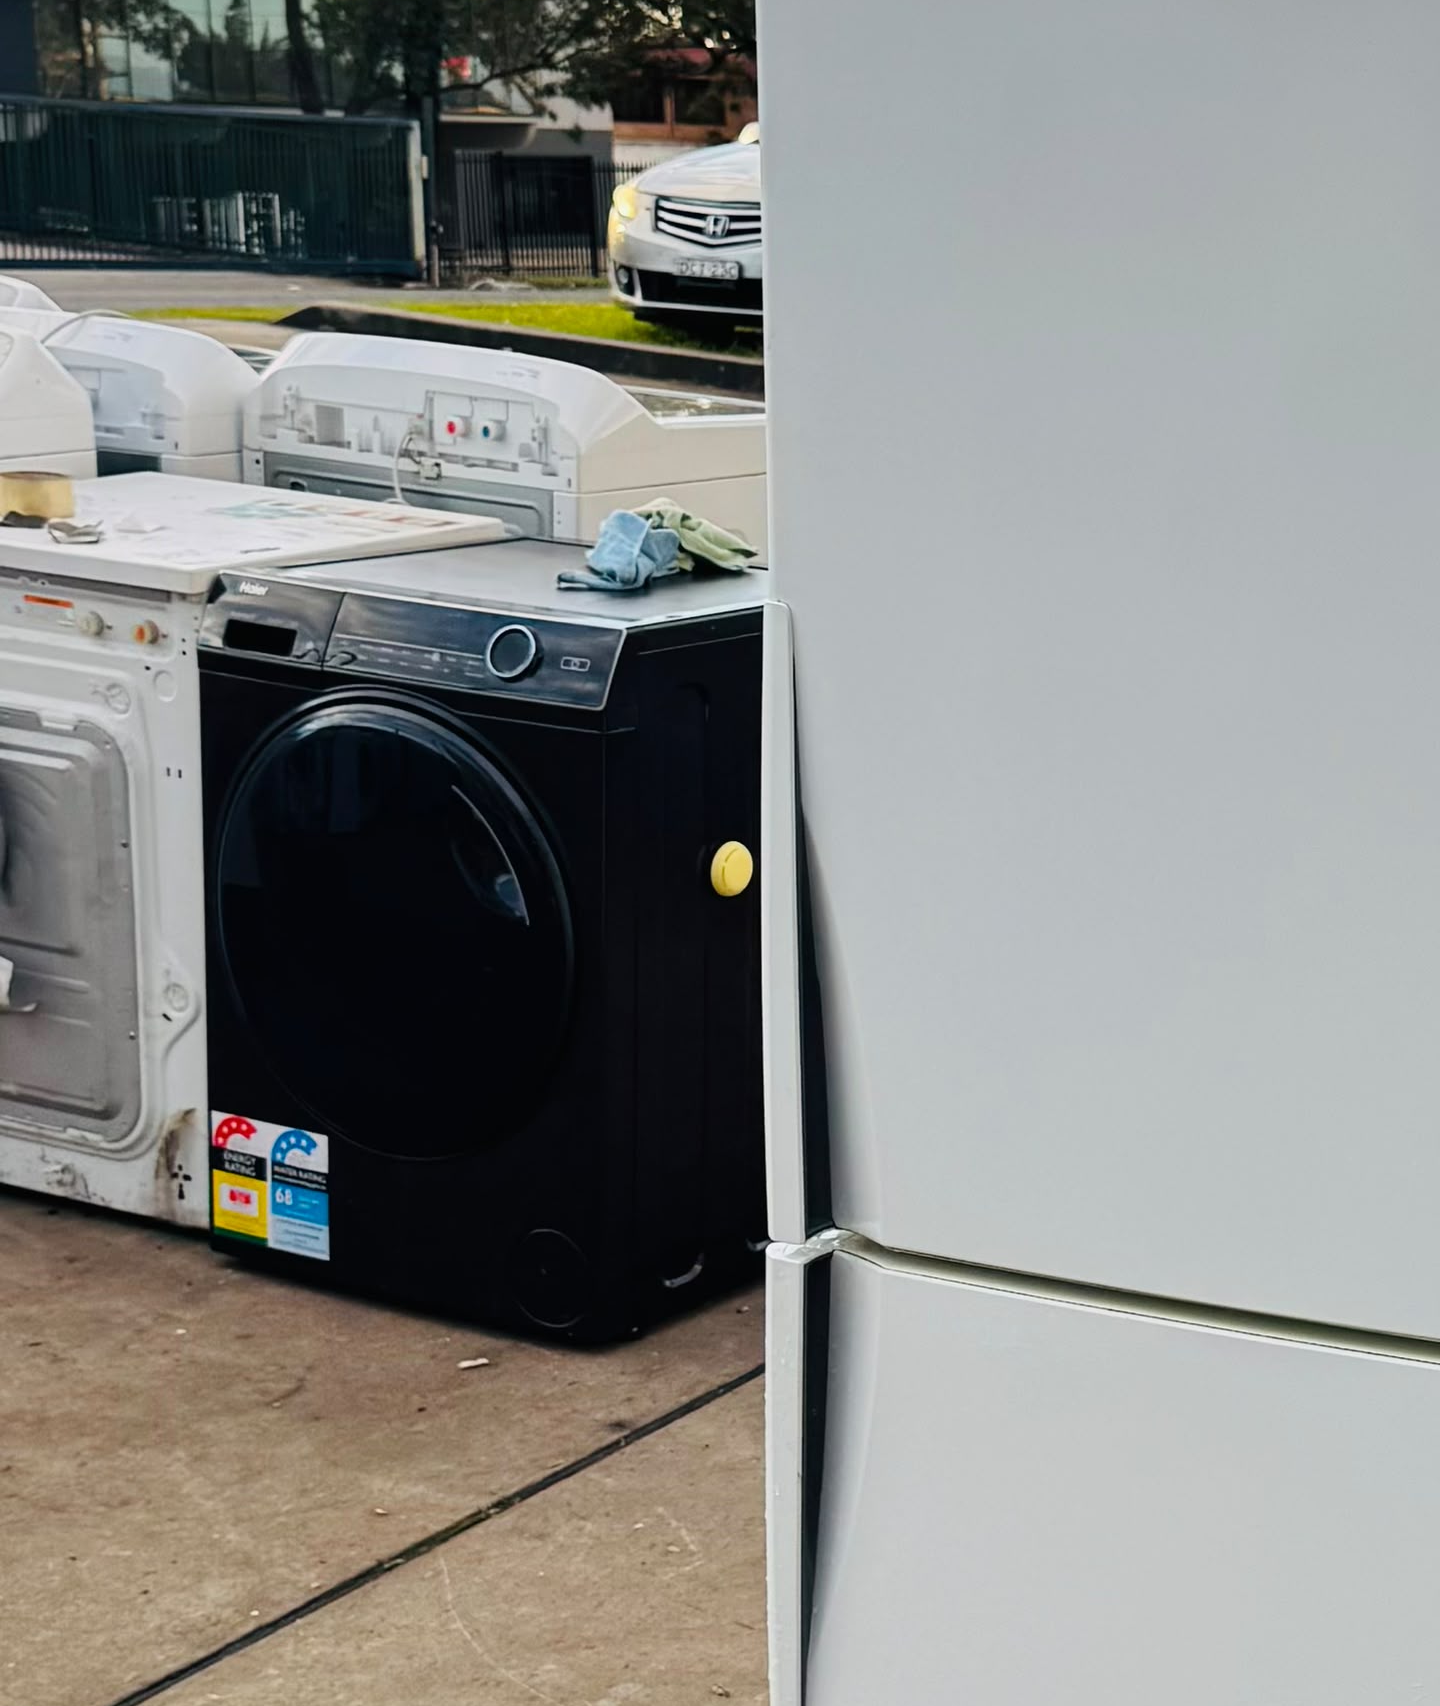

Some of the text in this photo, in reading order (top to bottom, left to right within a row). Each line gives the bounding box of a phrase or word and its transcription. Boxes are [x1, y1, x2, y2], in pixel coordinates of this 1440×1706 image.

[224, 1151, 256, 1165] ENERGY
[224, 1162, 256, 1176] RATING
[274, 1165, 298, 1177] WATER
[299, 1169, 327, 1184] RATING
[275, 1186, 293, 1205] 68
